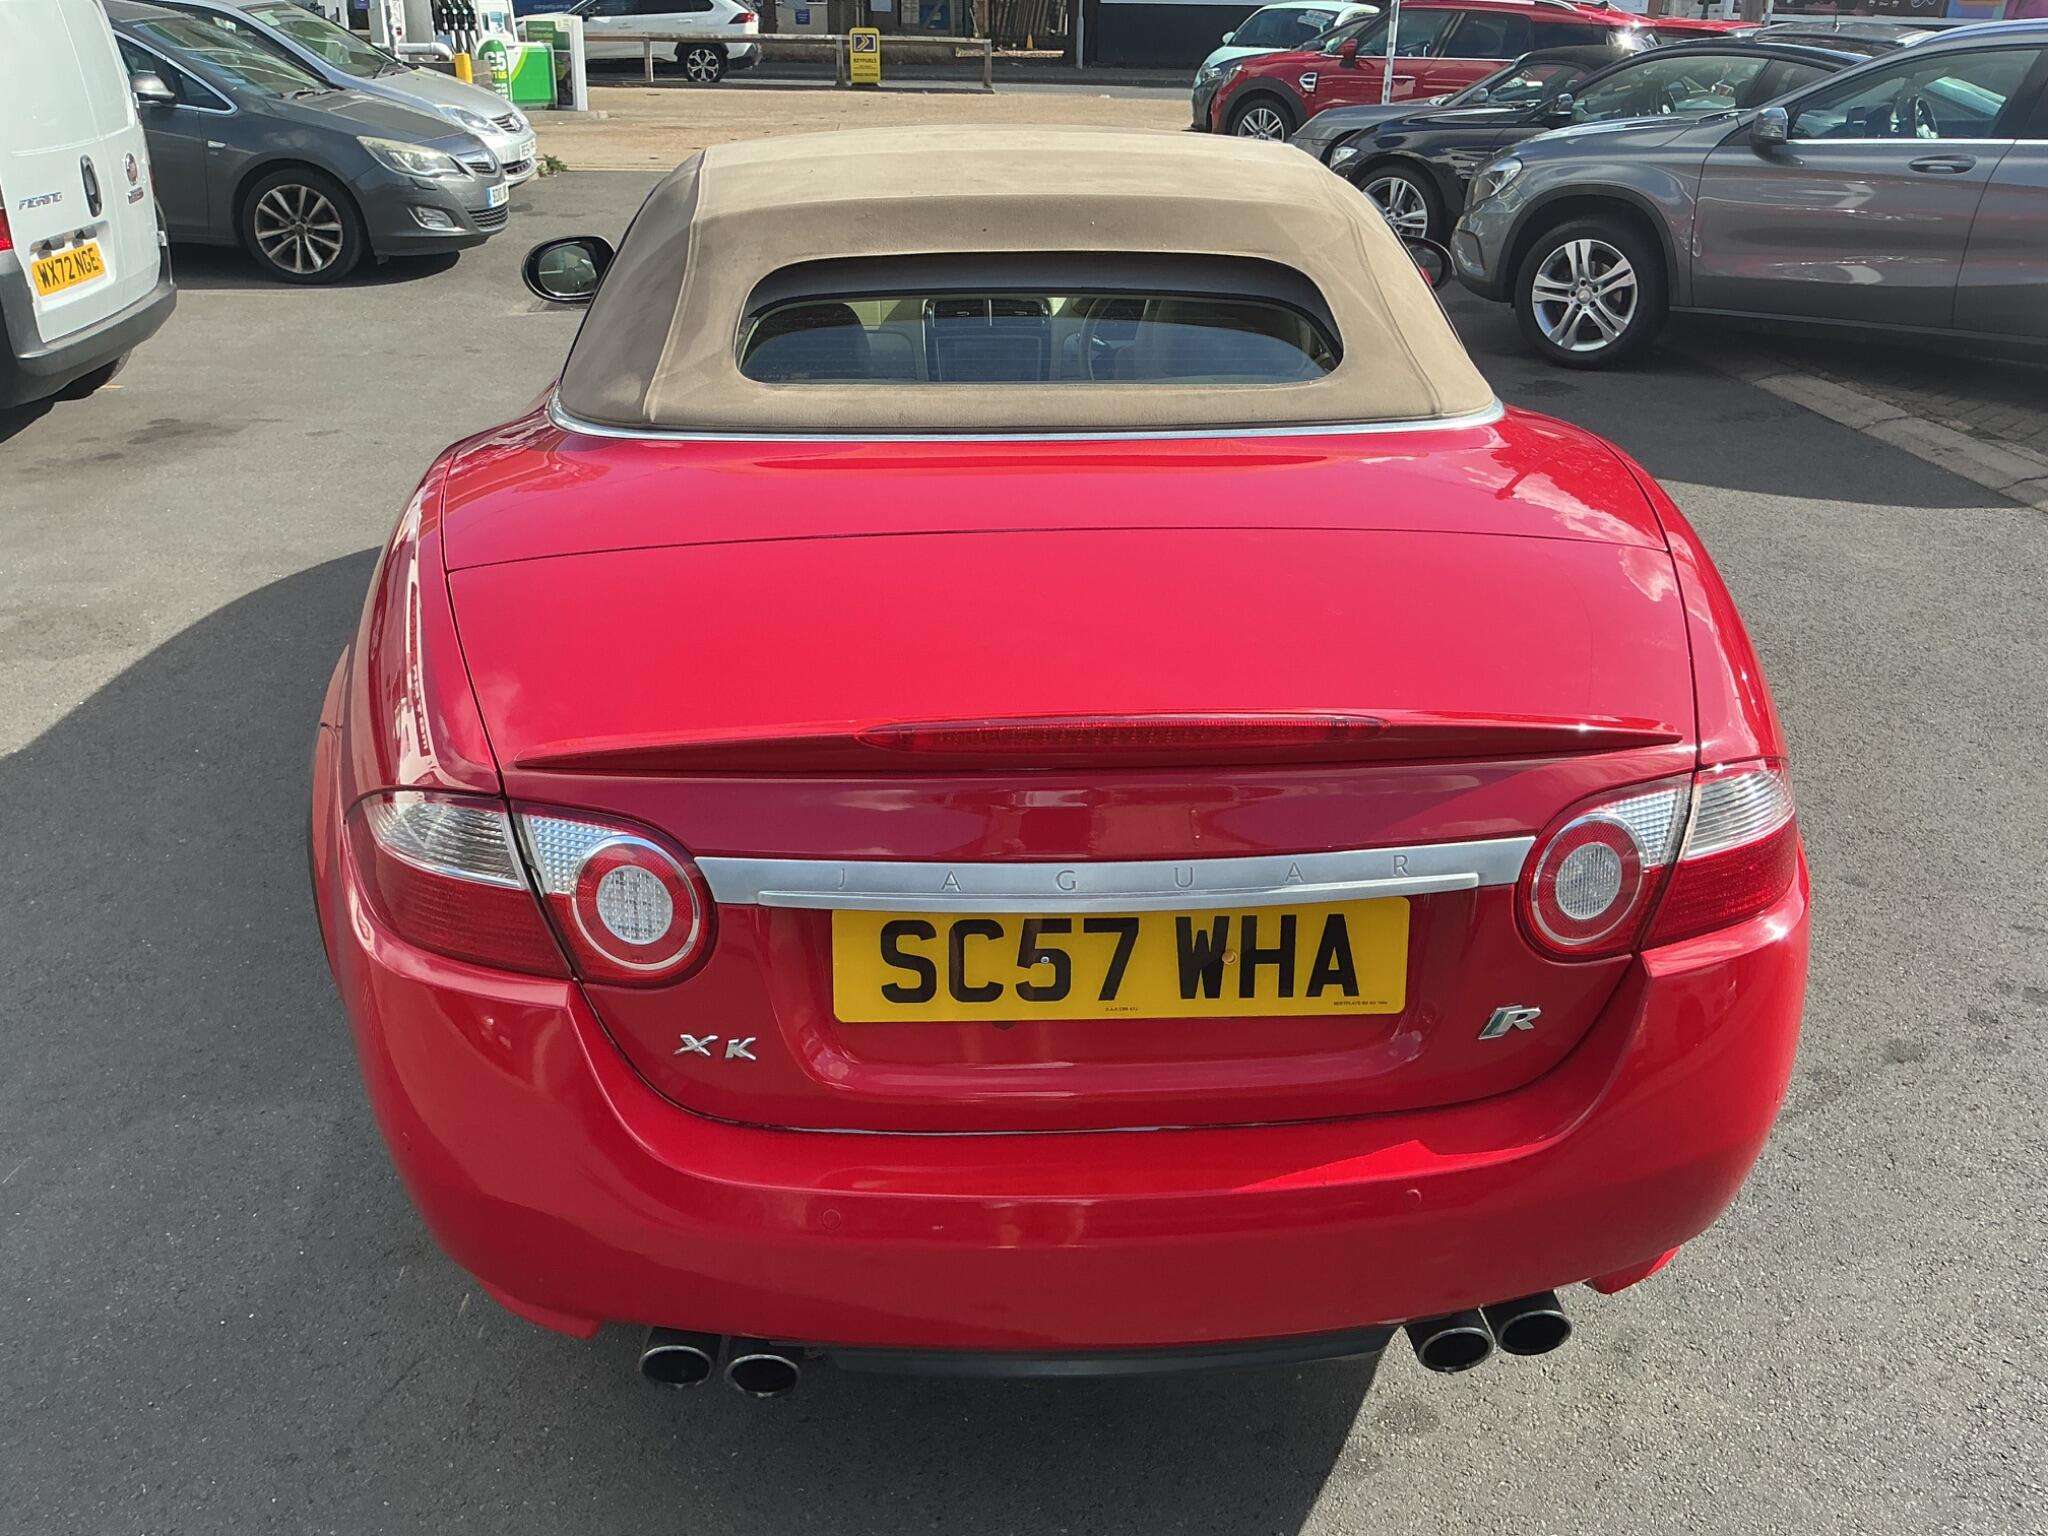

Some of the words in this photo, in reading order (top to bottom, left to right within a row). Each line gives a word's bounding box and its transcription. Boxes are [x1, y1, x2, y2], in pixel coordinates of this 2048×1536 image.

[37, 256, 75, 289] WX72
[73, 247, 99, 277] NGE
[838, 854, 1409, 892] JAGUAR
[880, 917, 1139, 1004] SC57
[1175, 913, 1360, 1000] WHA
[1478, 1005, 1542, 1040] R
